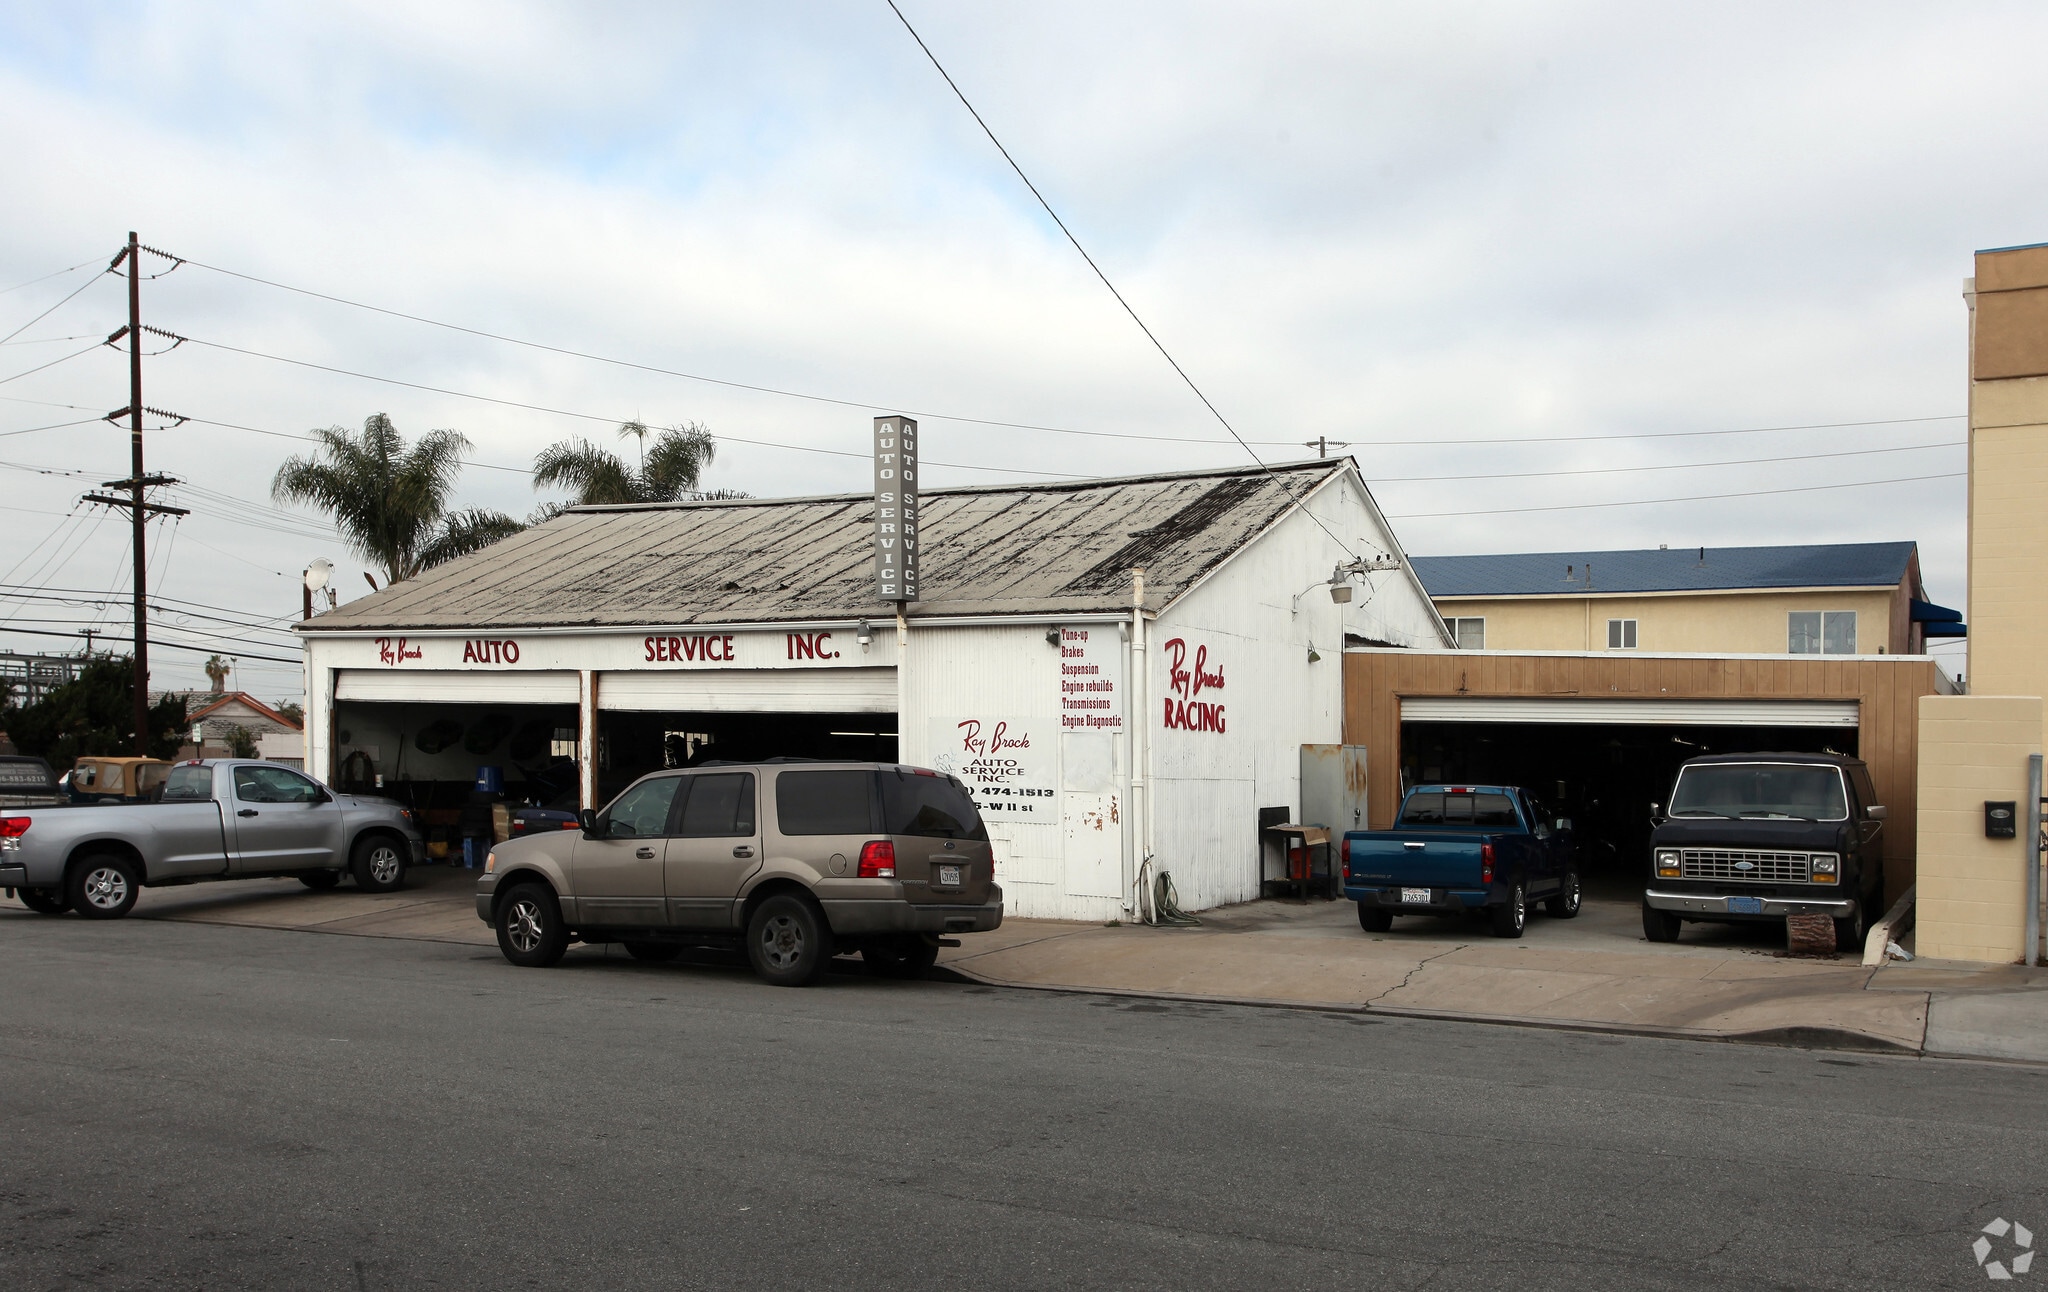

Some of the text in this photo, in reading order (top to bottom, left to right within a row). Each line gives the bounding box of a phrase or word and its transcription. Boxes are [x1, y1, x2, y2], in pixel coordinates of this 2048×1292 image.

[879, 423, 896, 594] AUTO SERVICE
[903, 424, 915, 596] AUTO SERVICE
[1061, 628, 1089, 643] Tune-up
[375, 633, 840, 666] Ray Brock AUTO SERVICE INC.
[1061, 646, 1084, 658] Brakes
[1061, 663, 1099, 677] Suspension
[1164, 638, 1225, 701] Ray Brock
[1062, 680, 1113, 695] Engine rebuilds
[1062, 697, 1111, 709] Transmissions
[1062, 714, 1122, 729] Engine Diagnostic
[1164, 697, 1226, 734] RACING
[958, 719, 1031, 757] Ray Brock
[970, 759, 1018, 767] AUTO
[962, 767, 1025, 776] SERVICE
[977, 775, 1010, 783] INC.
[981, 787, 1054, 798] 474-1513
[1021, 804, 1034, 812] st
